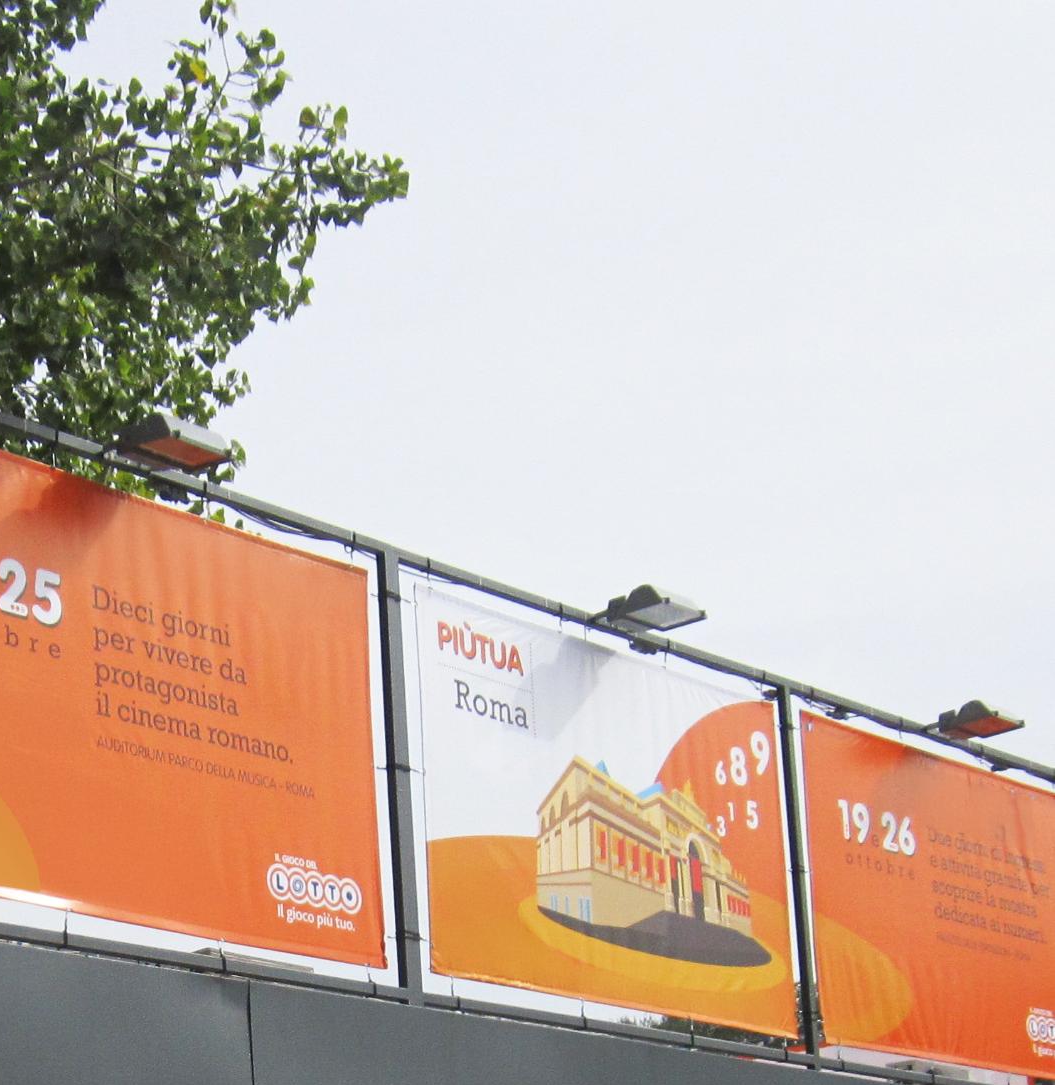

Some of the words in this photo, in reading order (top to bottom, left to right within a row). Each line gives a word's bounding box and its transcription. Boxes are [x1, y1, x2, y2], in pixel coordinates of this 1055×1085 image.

[92, 584, 154, 625] Dieci
[162, 611, 231, 647] giorni
[93, 627, 135, 654] per
[143, 639, 212, 675] vivere
[220, 659, 247, 685] da
[94, 662, 239, 716] protagonista
[454, 678, 529, 729] Roma
[96, 691, 111, 718] il
[118, 701, 201, 740] cinema
[208, 726, 293, 764] romano.
[837, 799, 869, 844] 19
[881, 811, 916, 856] 26
[270, 867, 359, 911] LOTTO
[277, 904, 284, 918] Il
[286, 907, 314, 923] gioco
[317, 912, 333, 928] più
[335, 916, 355, 932] tuo.
